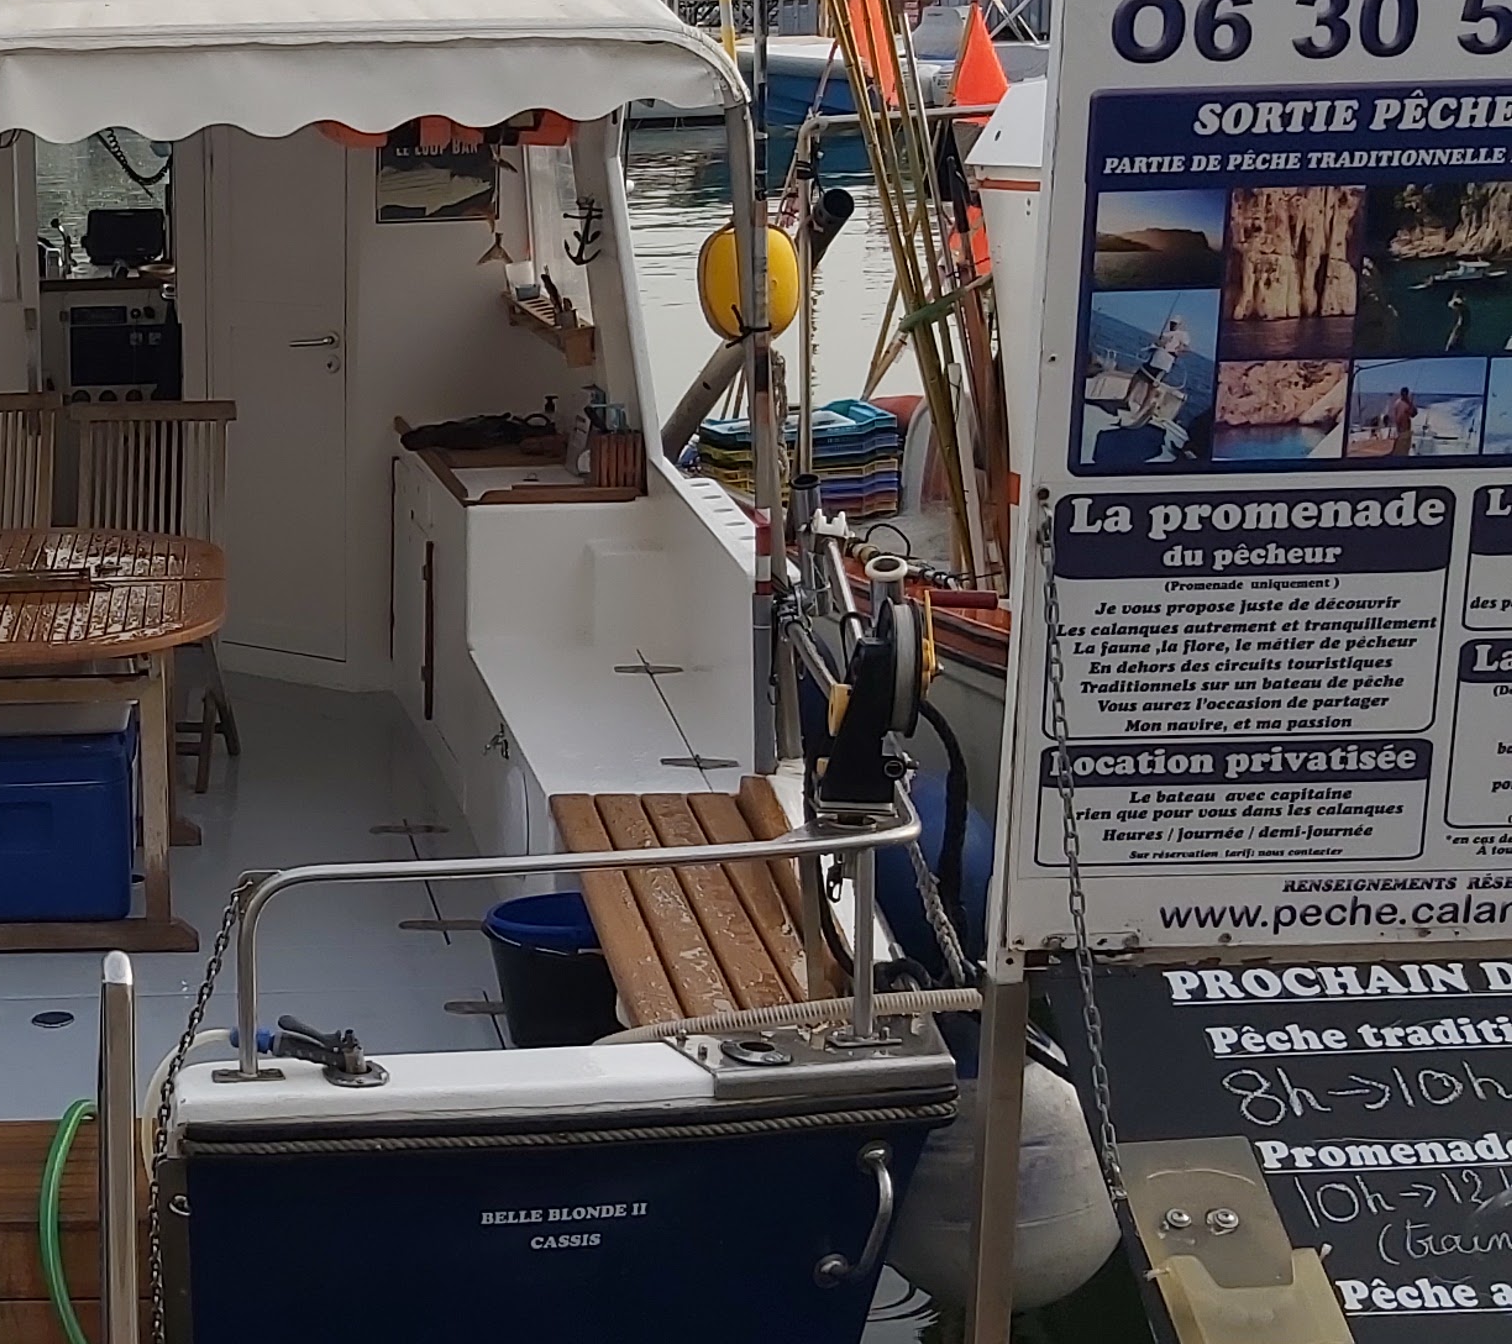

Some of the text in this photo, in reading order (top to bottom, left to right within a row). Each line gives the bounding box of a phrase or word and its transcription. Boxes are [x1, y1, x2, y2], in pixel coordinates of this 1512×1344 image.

[1193, 89, 1512, 136] SORTIE PÊCHE
[1103, 147, 1506, 175] PARTIE DE PÊCHE TRADITIONNELLE
[1069, 491, 1446, 540] La promenade
[1163, 543, 1342, 571] du pêcheur
[1164, 579, 1244, 593] (Promenade
[1094, 595, 1401, 619] Je vous propose juste de découvrir
[1470, 596, 1497, 610] des
[1056, 615, 1437, 640] Les calanques autrement et tranquillement
[1072, 641, 1095, 656] La
[1100, 641, 1152, 658] faune
[1234, 638, 1252, 652] le
[1256, 636, 1315, 652] métier
[1319, 636, 1341, 650] de
[1344, 634, 1417, 652] pêcheur
[1087, 655, 1392, 674] En dehors des circuits touristiques
[1080, 672, 1404, 694] Traditionnels sur un bateau de pêche
[1097, 699, 1137, 713] Vous
[1141, 700, 1190, 712] aurez
[1286, 694, 1308, 708] de
[1312, 694, 1390, 713] partager
[1124, 714, 1352, 734] Mon navire, et ma passion
[1225, 743, 1417, 780] privatisée
[1129, 786, 1353, 804] Le bateau avec capitaine
[1075, 802, 1404, 824] rien que pour vous dans les calanques
[1101, 827, 1164, 843] Heures
[1176, 824, 1245, 844] journée
[1258, 822, 1374, 842] demi-journée
[1282, 876, 1457, 894] RENSEIGNEMENTS
[1162, 962, 1470, 1001] PROCHAIN
[1205, 1024, 1348, 1055] Pêche
[1294, 1174, 1396, 1228] 10h
[480, 1203, 648, 1225] BELLE BLONDE II
[530, 1233, 602, 1250] CASSIS
[1335, 1277, 1479, 1311] Pêche
